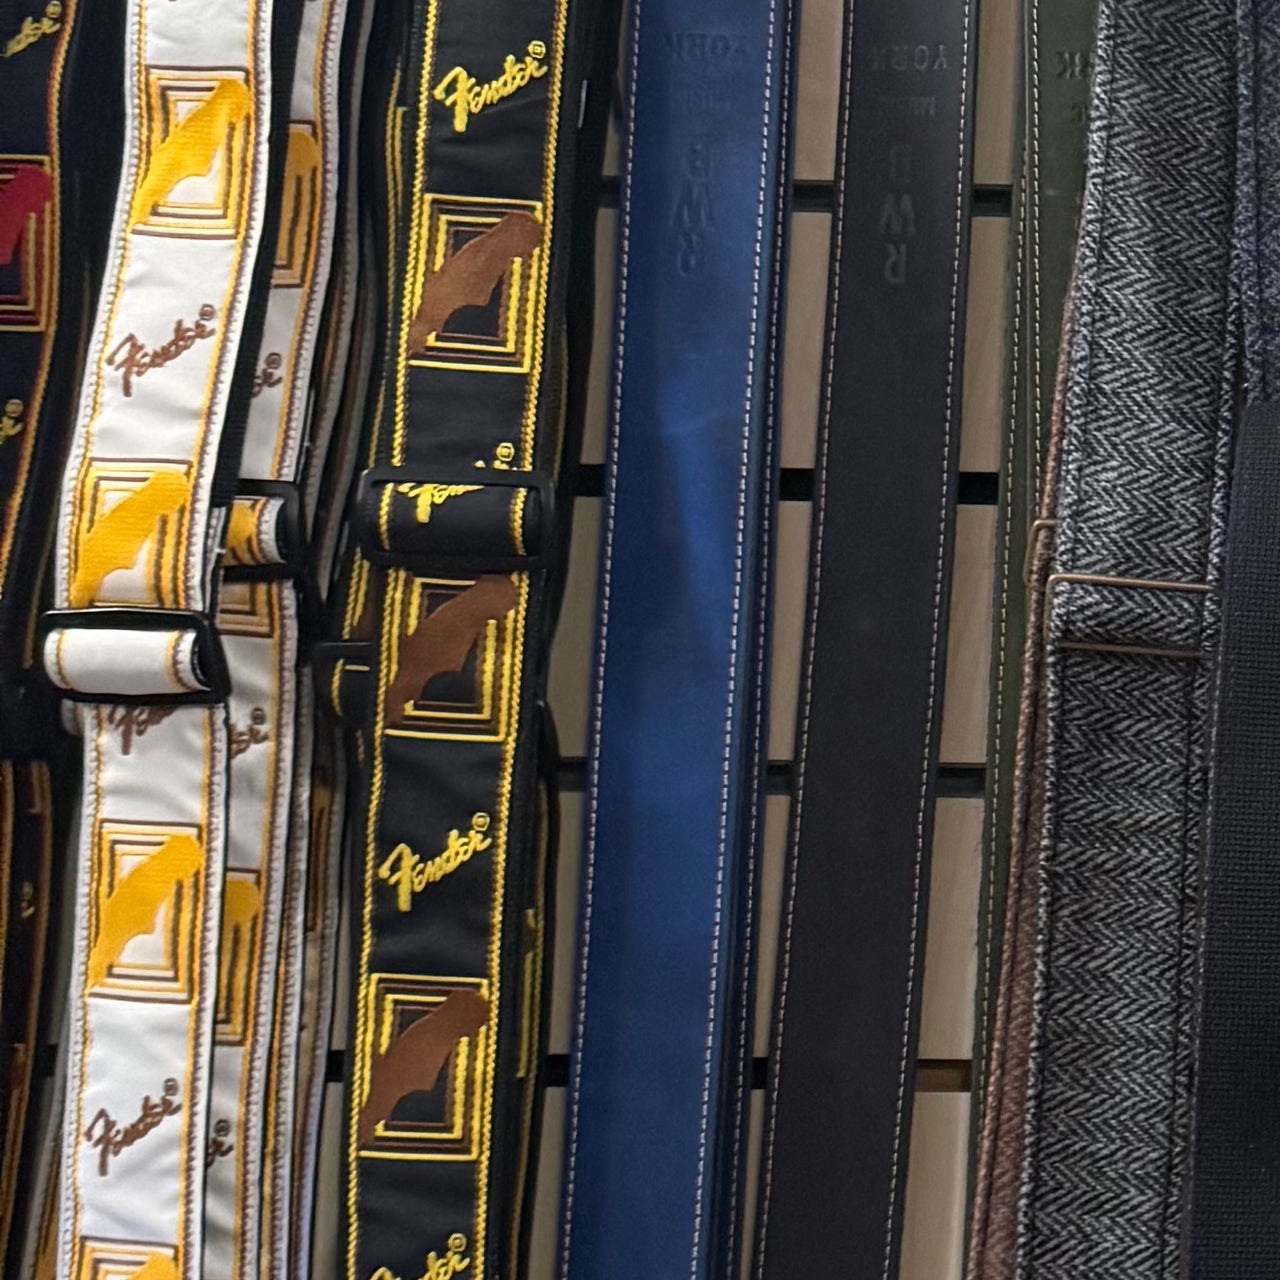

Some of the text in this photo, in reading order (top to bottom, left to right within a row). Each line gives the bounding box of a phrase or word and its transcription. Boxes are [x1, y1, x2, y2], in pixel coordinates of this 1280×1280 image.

[433, 54, 548, 132] Fender
[107, 318, 216, 397] Fender
[379, 828, 492, 912] Fender
[86, 1094, 183, 1177] Fender
